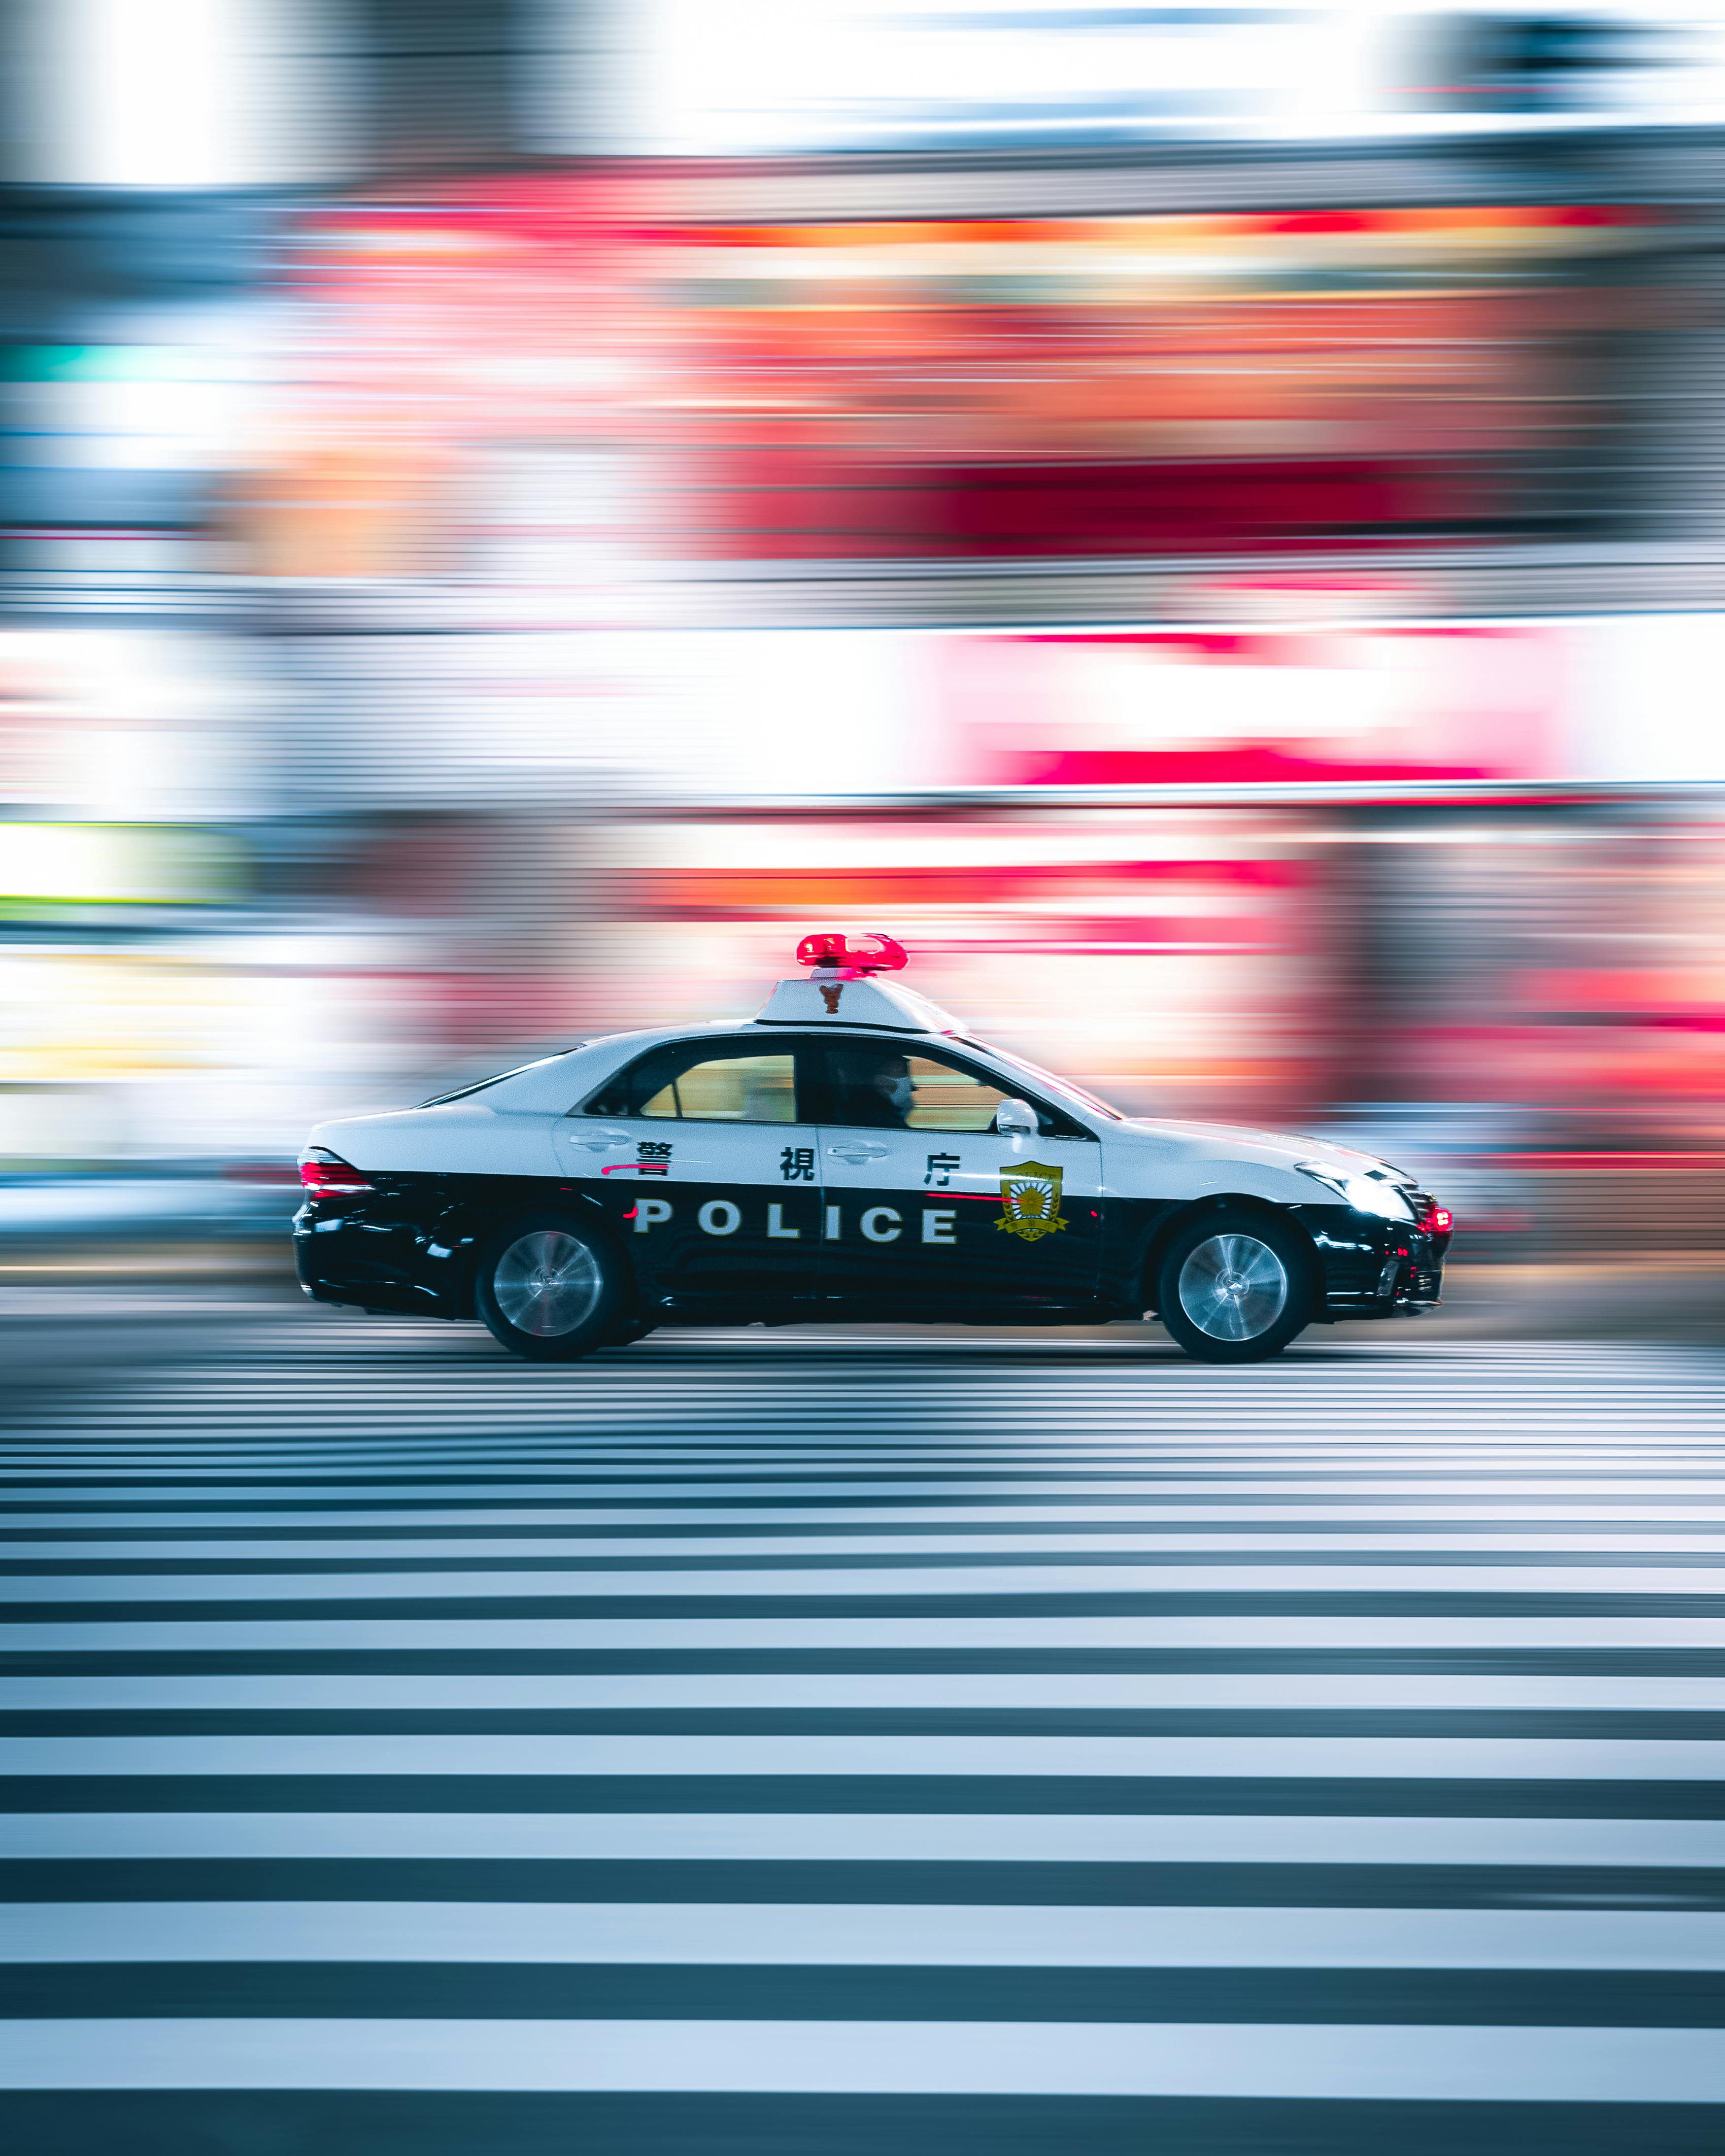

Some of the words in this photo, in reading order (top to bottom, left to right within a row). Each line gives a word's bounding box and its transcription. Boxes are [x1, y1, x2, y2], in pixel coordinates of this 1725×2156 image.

[636, 1141, 960, 1186] 警視庁
[633, 1198, 958, 1244] POLICE
